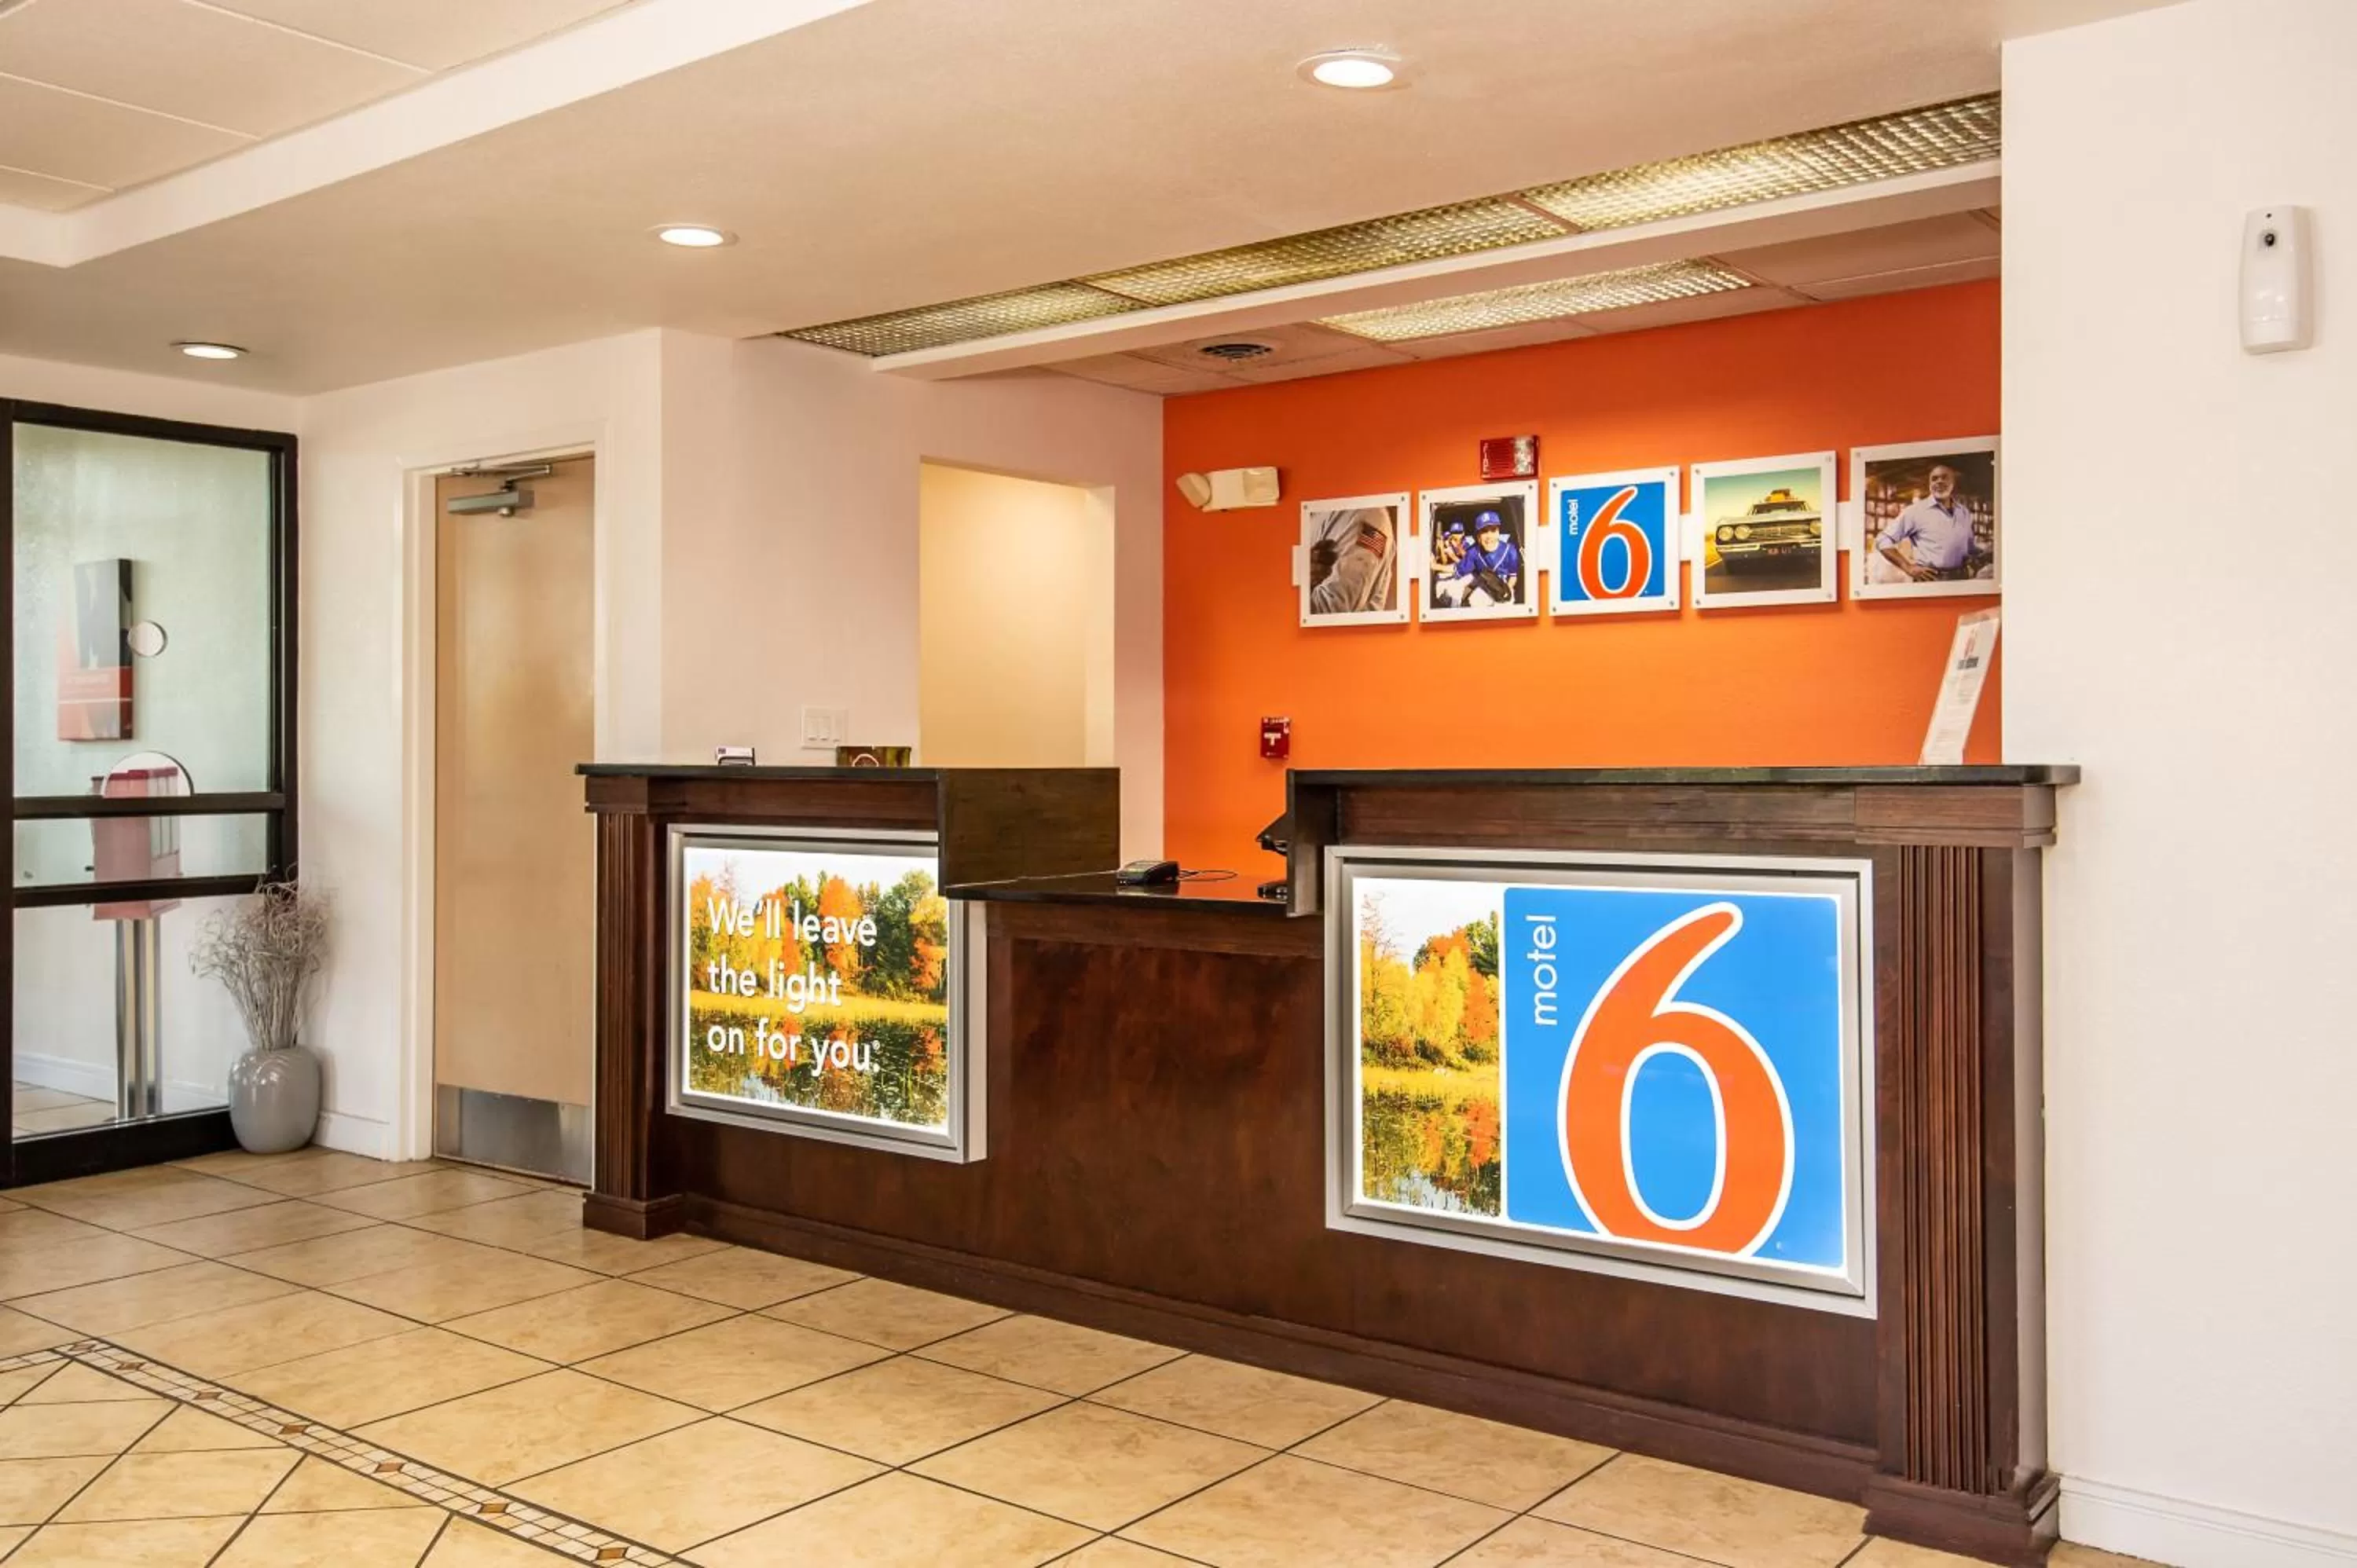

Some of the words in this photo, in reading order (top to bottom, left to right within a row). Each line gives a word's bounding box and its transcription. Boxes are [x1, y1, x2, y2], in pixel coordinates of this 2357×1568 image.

[1567, 498, 1578, 535] motel
[1577, 485, 1653, 600] 6
[707, 896, 780, 940] We'll
[794, 899, 878, 947] leave
[708, 954, 757, 997] the
[767, 958, 842, 1013] light
[707, 1024, 745, 1055] on
[754, 1017, 802, 1061] for
[1525, 914, 1558, 1026] motel
[1557, 901, 1795, 1258] 6
